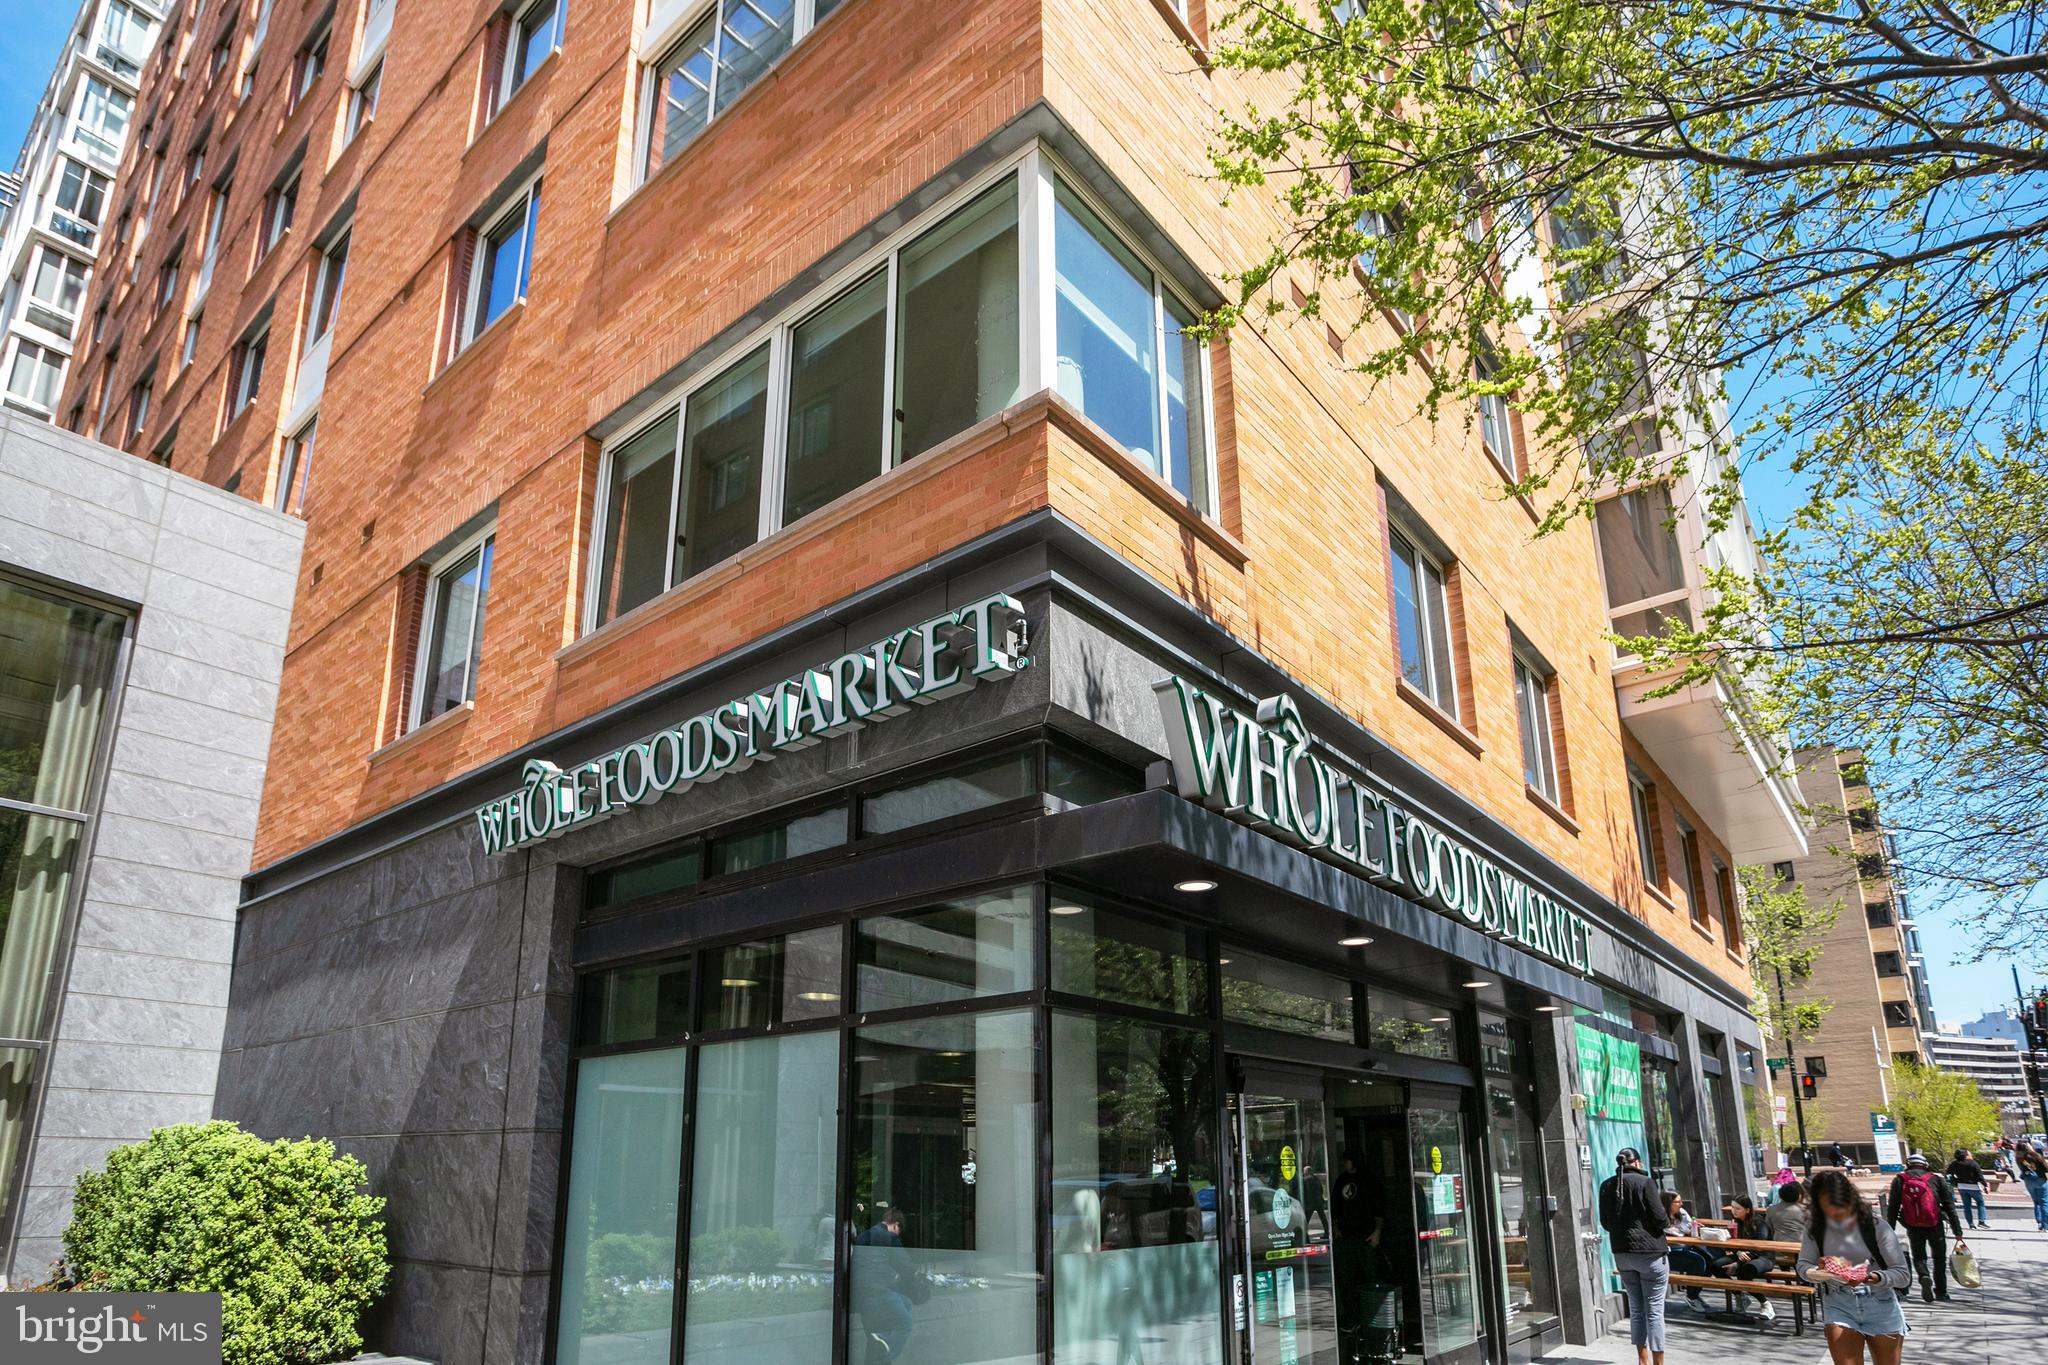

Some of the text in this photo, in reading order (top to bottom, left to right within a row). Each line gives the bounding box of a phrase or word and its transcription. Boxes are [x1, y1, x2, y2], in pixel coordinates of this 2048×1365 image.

[475, 758, 596, 855] WHOLE
[597, 701, 741, 813] FOODS
[743, 592, 1019, 758] MARKET
[1168, 674, 1595, 977] WHOLE FOODS MARKET
